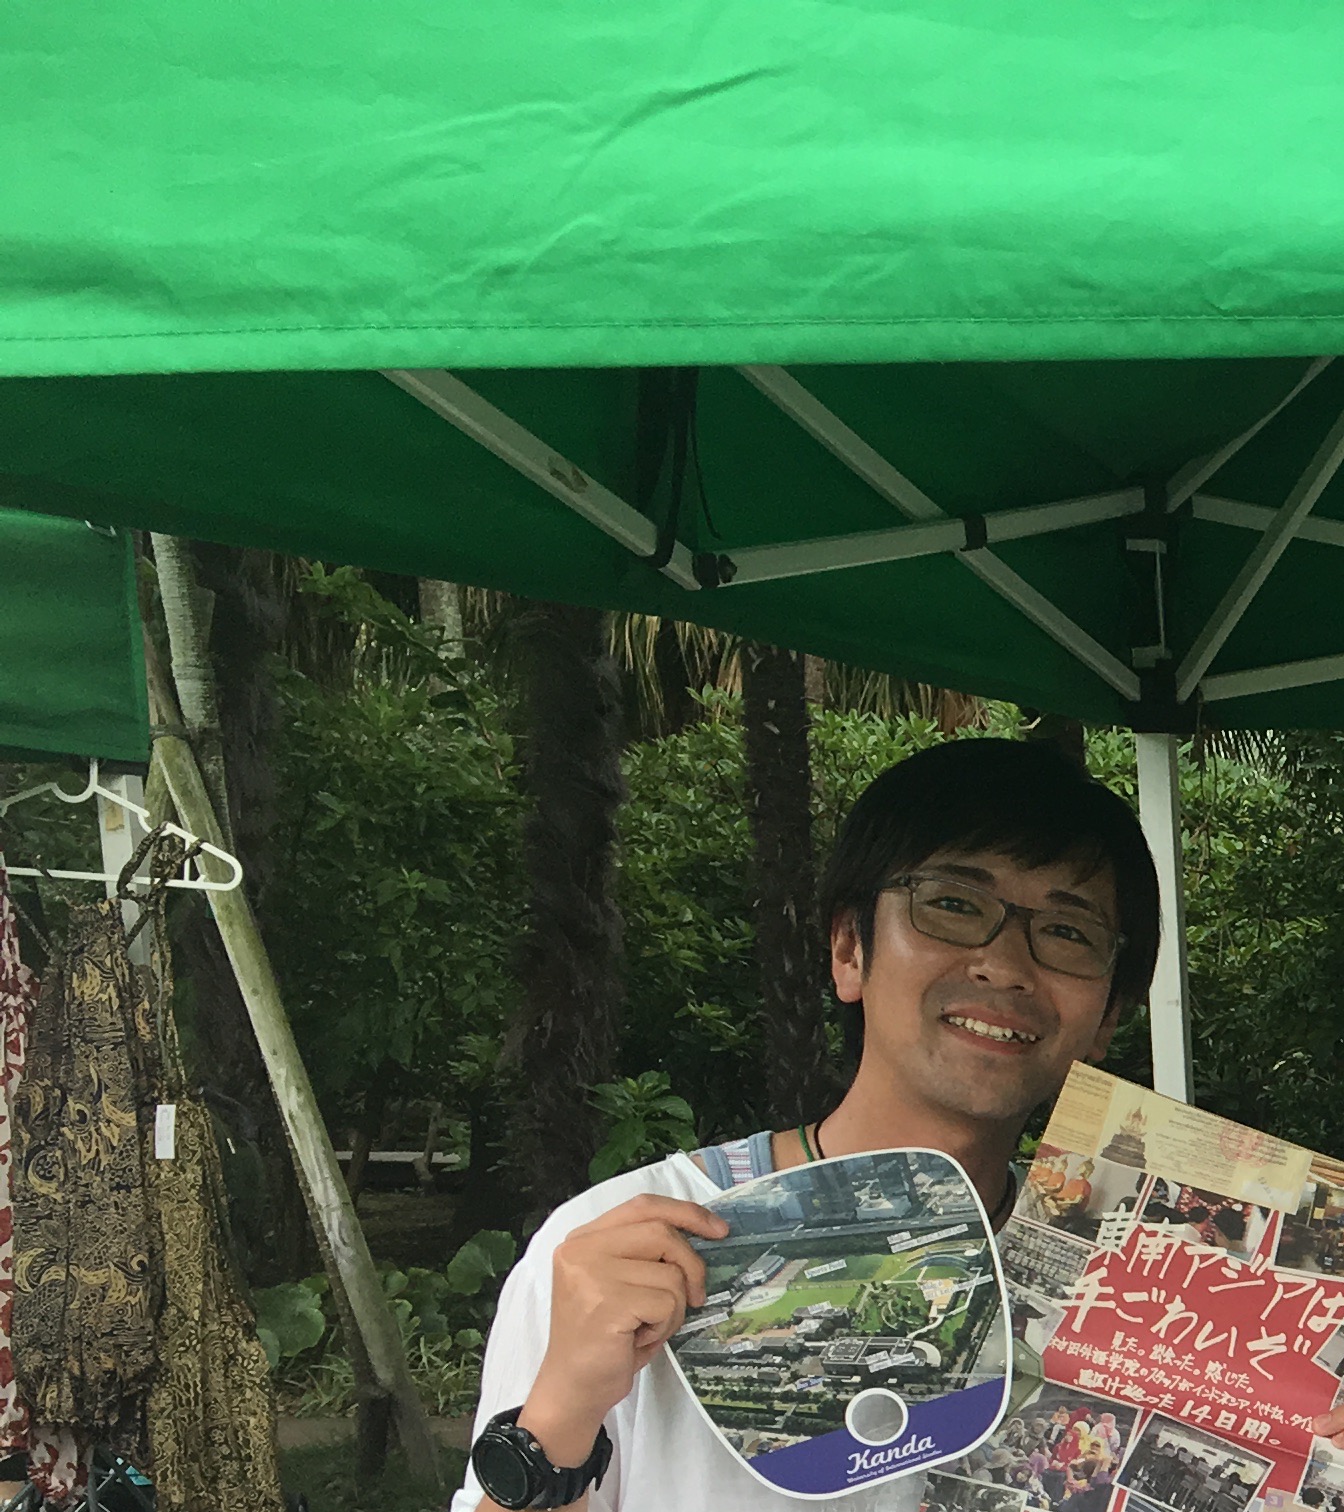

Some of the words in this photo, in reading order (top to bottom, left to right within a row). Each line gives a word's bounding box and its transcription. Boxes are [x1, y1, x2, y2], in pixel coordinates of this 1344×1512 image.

[1057, 1267, 1311, 1381] 手ごわいぞ
[847, 1434, 936, 1475] Kanda
